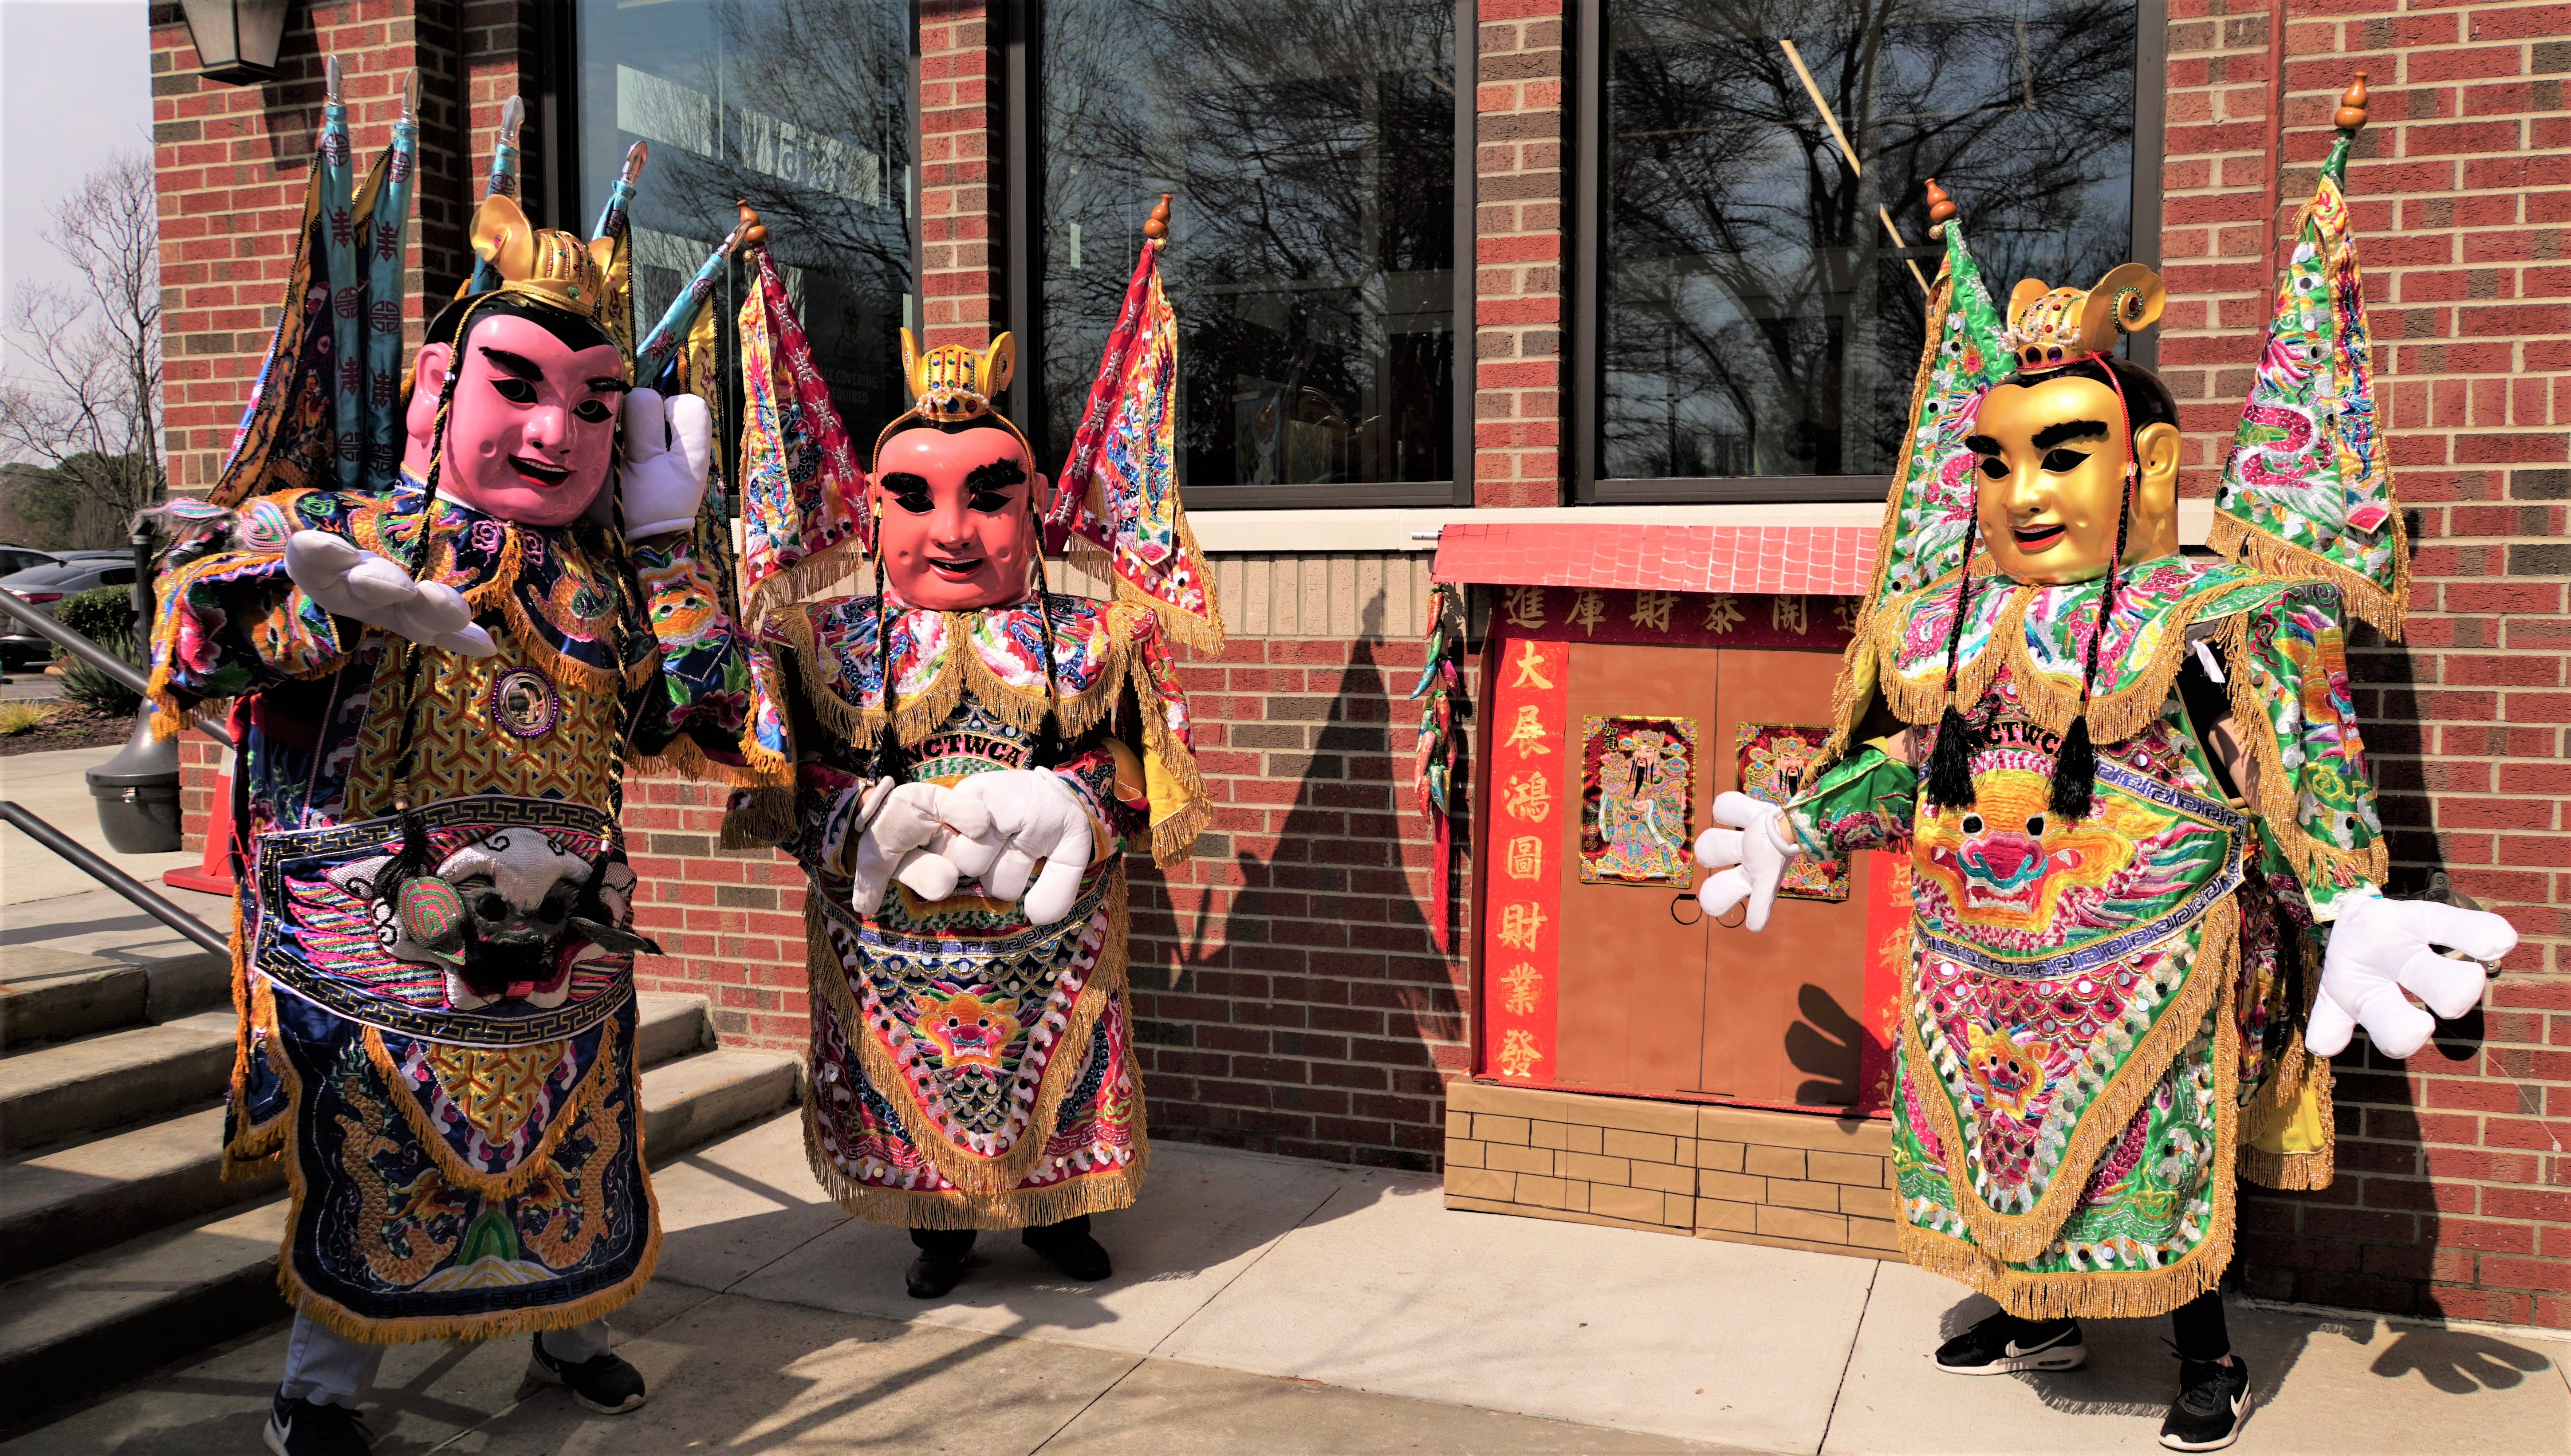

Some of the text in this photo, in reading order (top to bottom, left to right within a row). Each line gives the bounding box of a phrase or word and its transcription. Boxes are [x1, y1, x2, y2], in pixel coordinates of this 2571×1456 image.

[819, 367, 878, 389] CE COVERING
[831, 386, 869, 405] EQUIRED
[901, 734, 1021, 768] NCTWCA
[1602, 723, 1619, 751] 加冠
[1970, 721, 2064, 759] CTWC
[1496, 640, 1554, 1077] 大展鴻圖財業發
